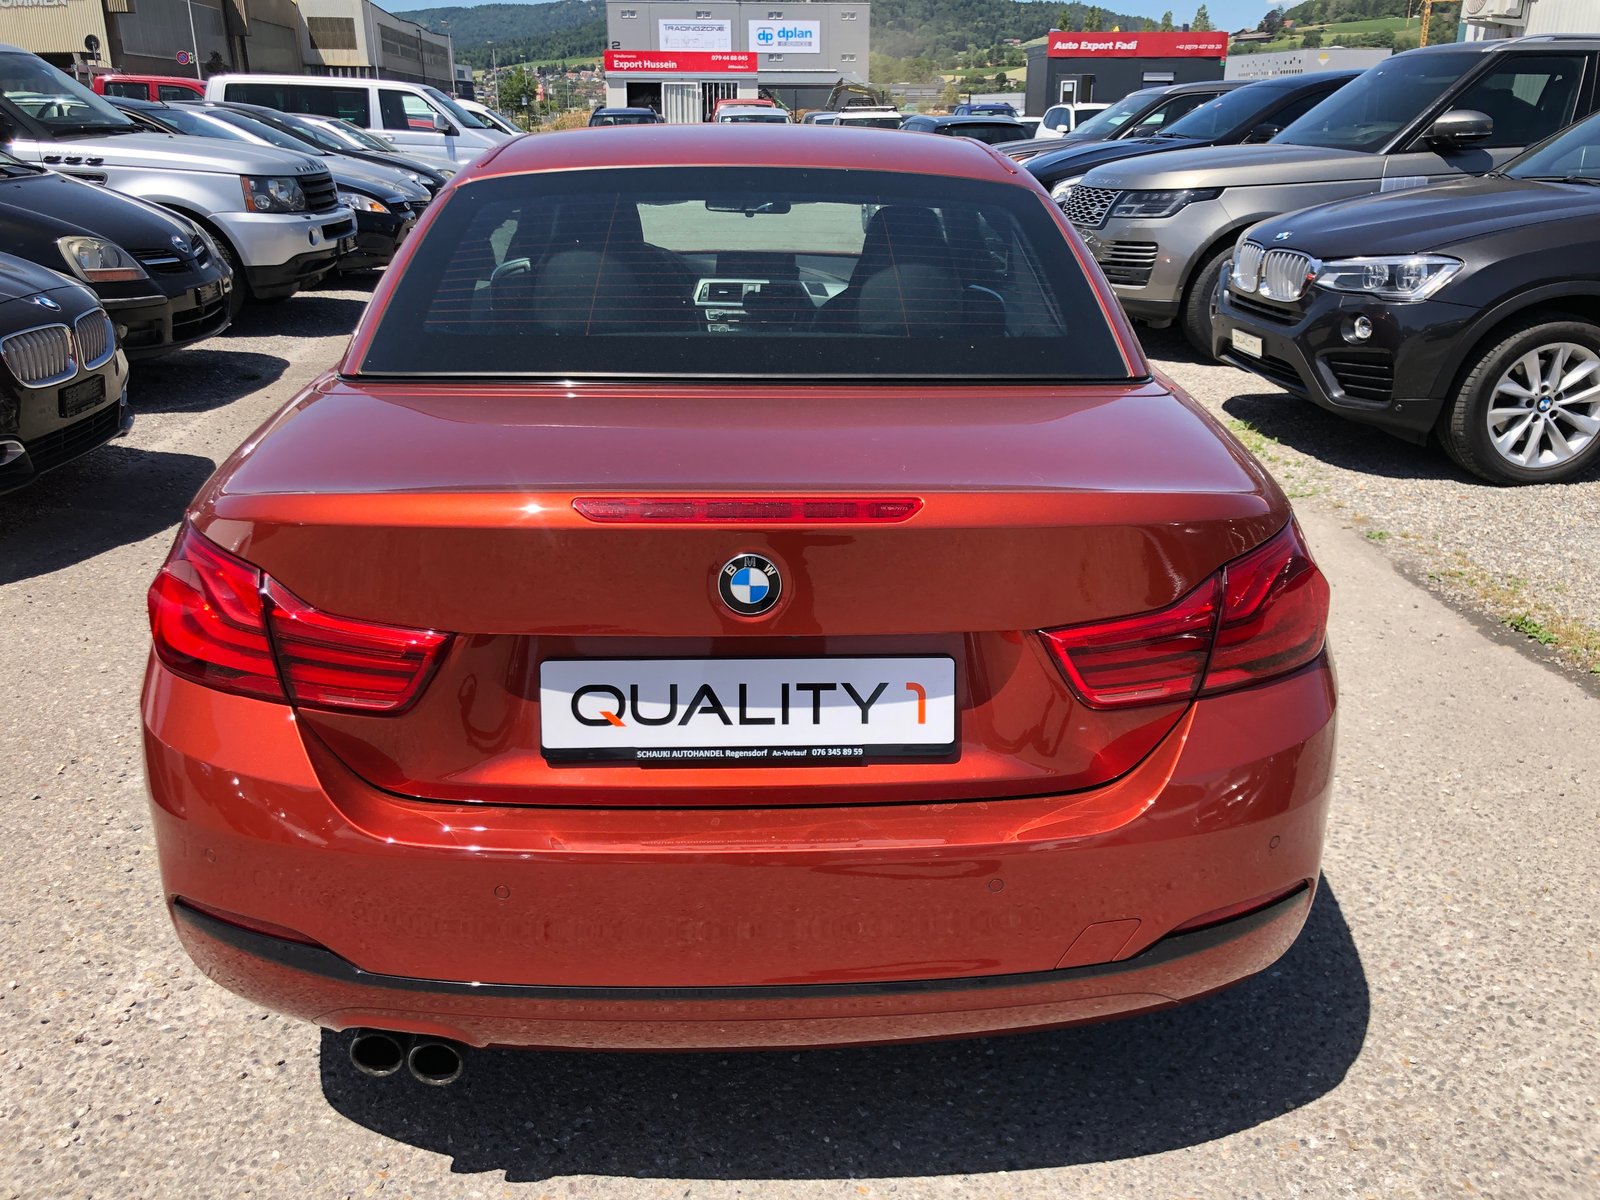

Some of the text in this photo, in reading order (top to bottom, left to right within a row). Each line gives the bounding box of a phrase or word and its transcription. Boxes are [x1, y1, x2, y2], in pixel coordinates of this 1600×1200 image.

[757, 29, 774, 44] dp
[777, 27, 813, 41] dplan
[611, 41, 621, 50] 2
[1054, 40, 1138, 51] Auto Export Fadi
[613, 60, 678, 70] Export Hussein
[570, 682, 927, 727] QUALITY 1
[636, 748, 863, 759] SCHAUKI AUTOHANDEL Regensdorf An-Verkauf 076 345 89 59
